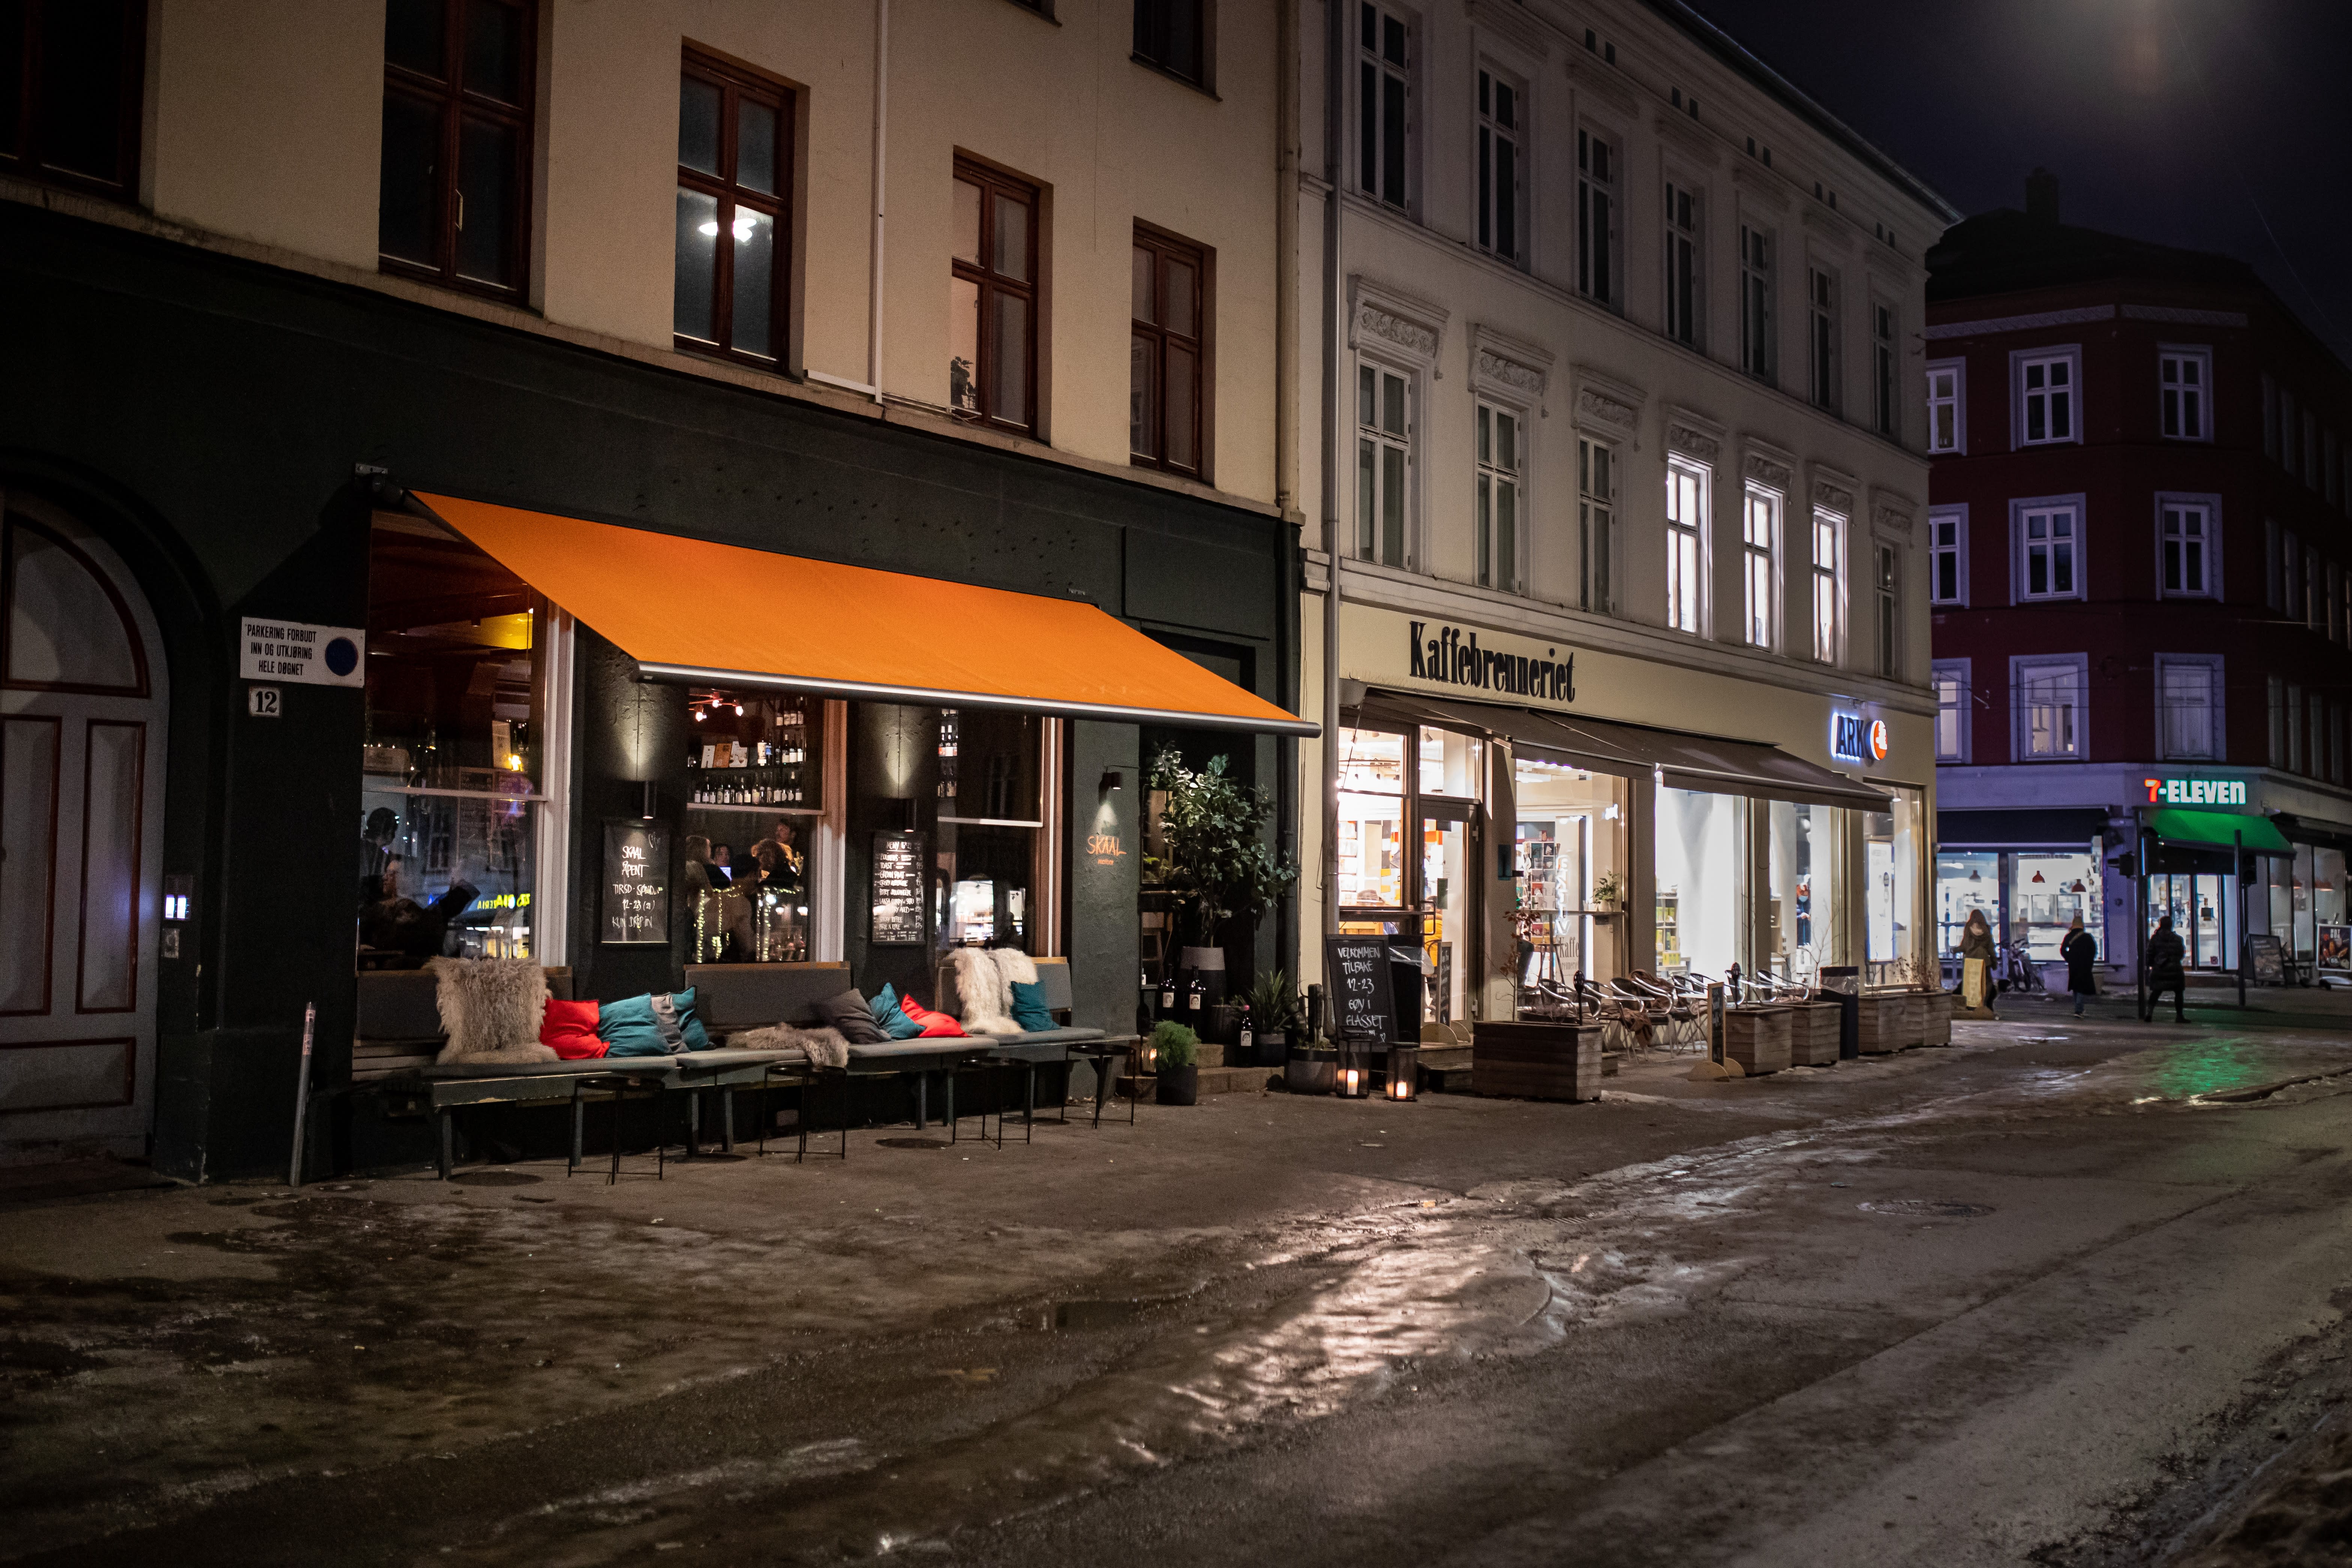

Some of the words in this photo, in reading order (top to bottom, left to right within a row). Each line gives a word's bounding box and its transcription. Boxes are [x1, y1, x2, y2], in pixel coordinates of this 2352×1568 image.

[247, 624, 284, 639] PARKERING
[287, 628, 316, 643] FORBUDT
[251, 642, 262, 654] INN
[265, 644, 273, 656] OG
[277, 645, 312, 659] UTKJØRING
[259, 660, 274, 673] HELE
[278, 662, 303, 676] DØGNET
[1409, 620, 1576, 703] Kaffebrenneriet
[256, 691, 277, 713] 12
[1831, 712, 1864, 760] ARK
[622, 846, 646, 859] SKAAL
[622, 861, 649, 877] ÅPENT
[612, 916, 626, 928] KUN
[1338, 947, 1380, 958] VELKOMMEN
[1342, 961, 1373, 975] TILBAKE
[1347, 978, 1374, 994] 12-23
